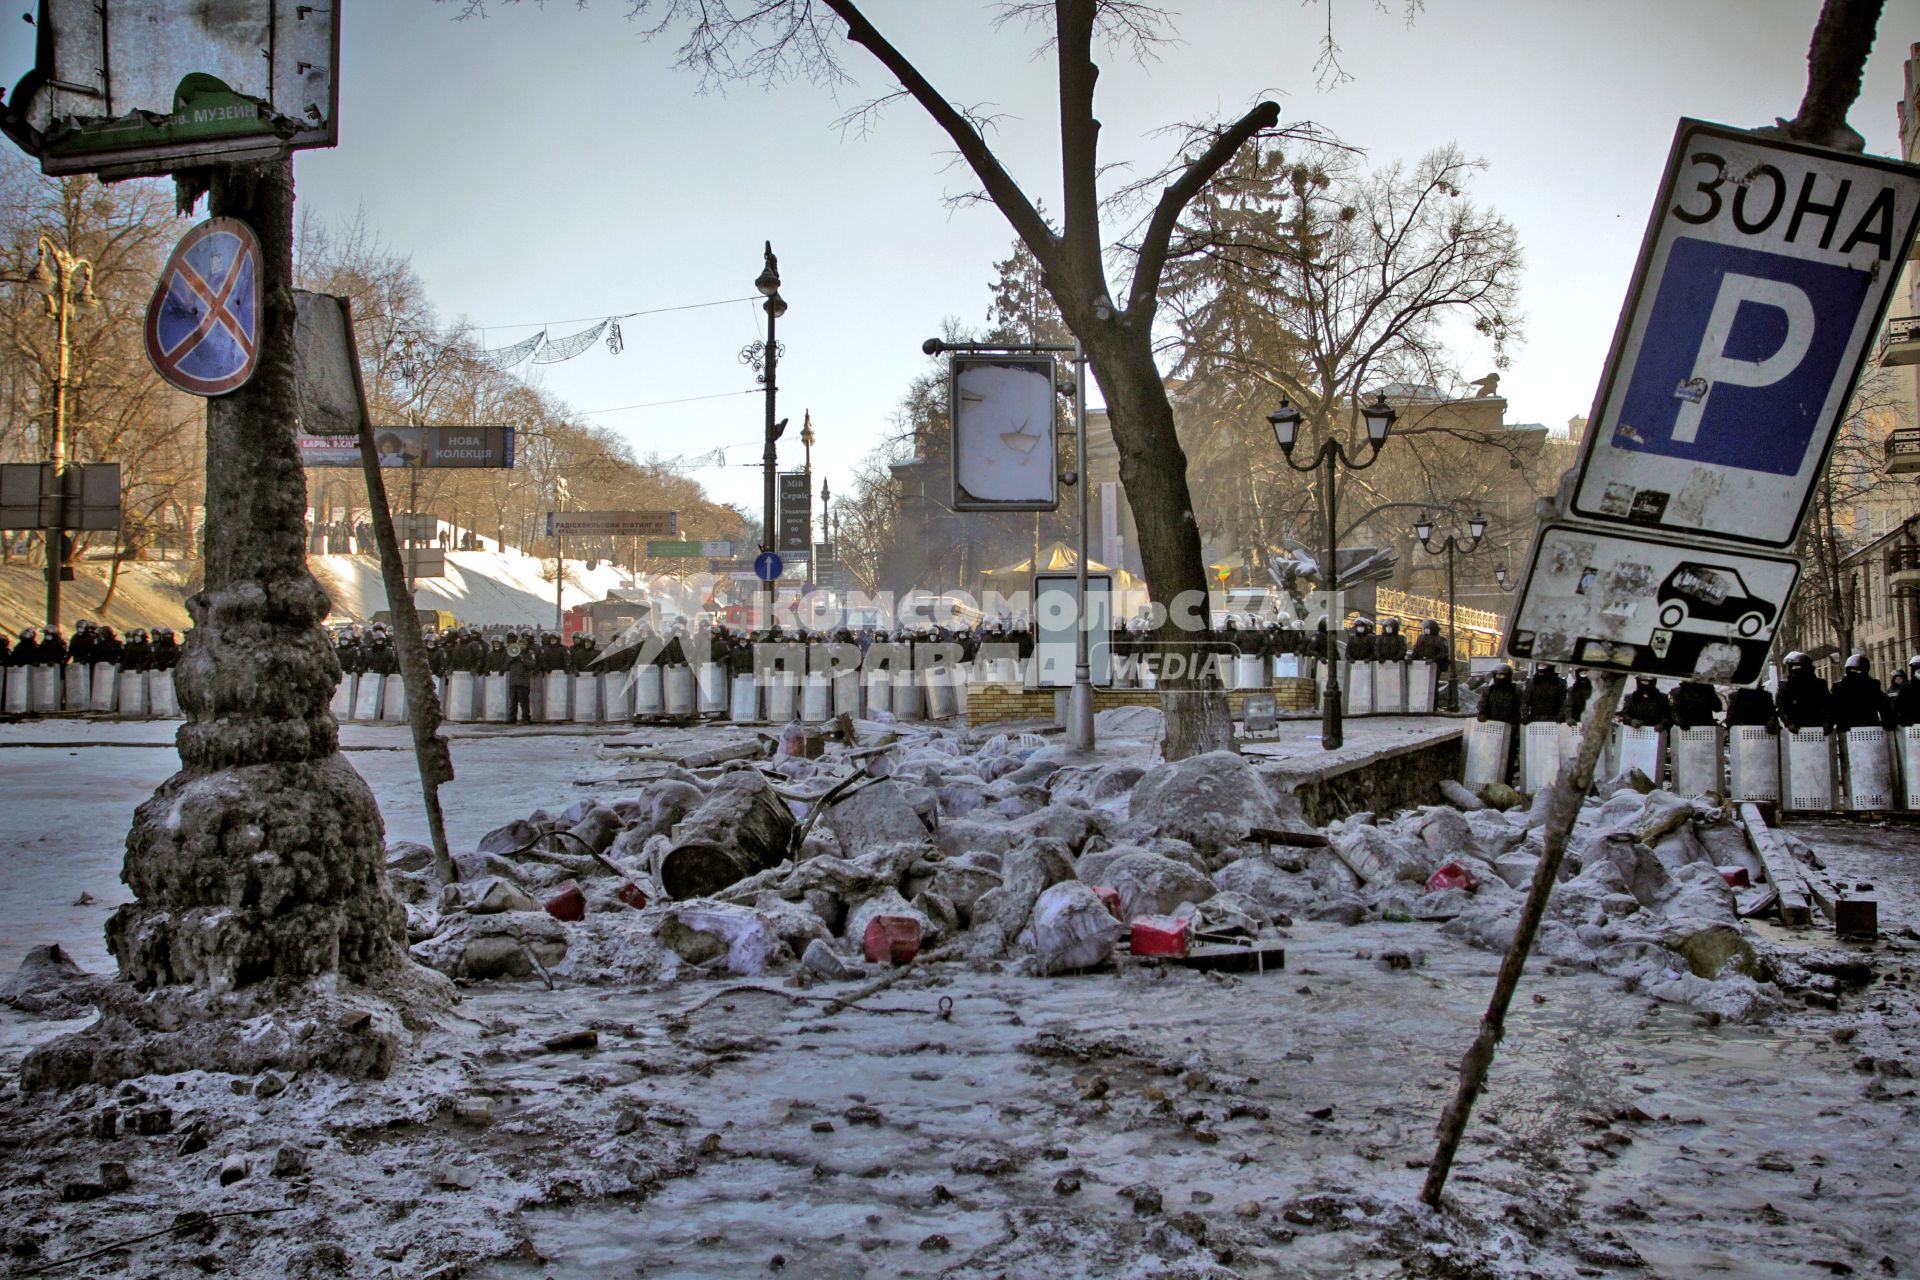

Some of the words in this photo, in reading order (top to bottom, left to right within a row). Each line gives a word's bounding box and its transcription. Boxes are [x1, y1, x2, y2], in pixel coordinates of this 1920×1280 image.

[1671, 152, 1895, 261] ЗОНА
[448, 436, 480, 446] НОВА
[435, 449, 492, 460] КОЛЕКЦІЯ
